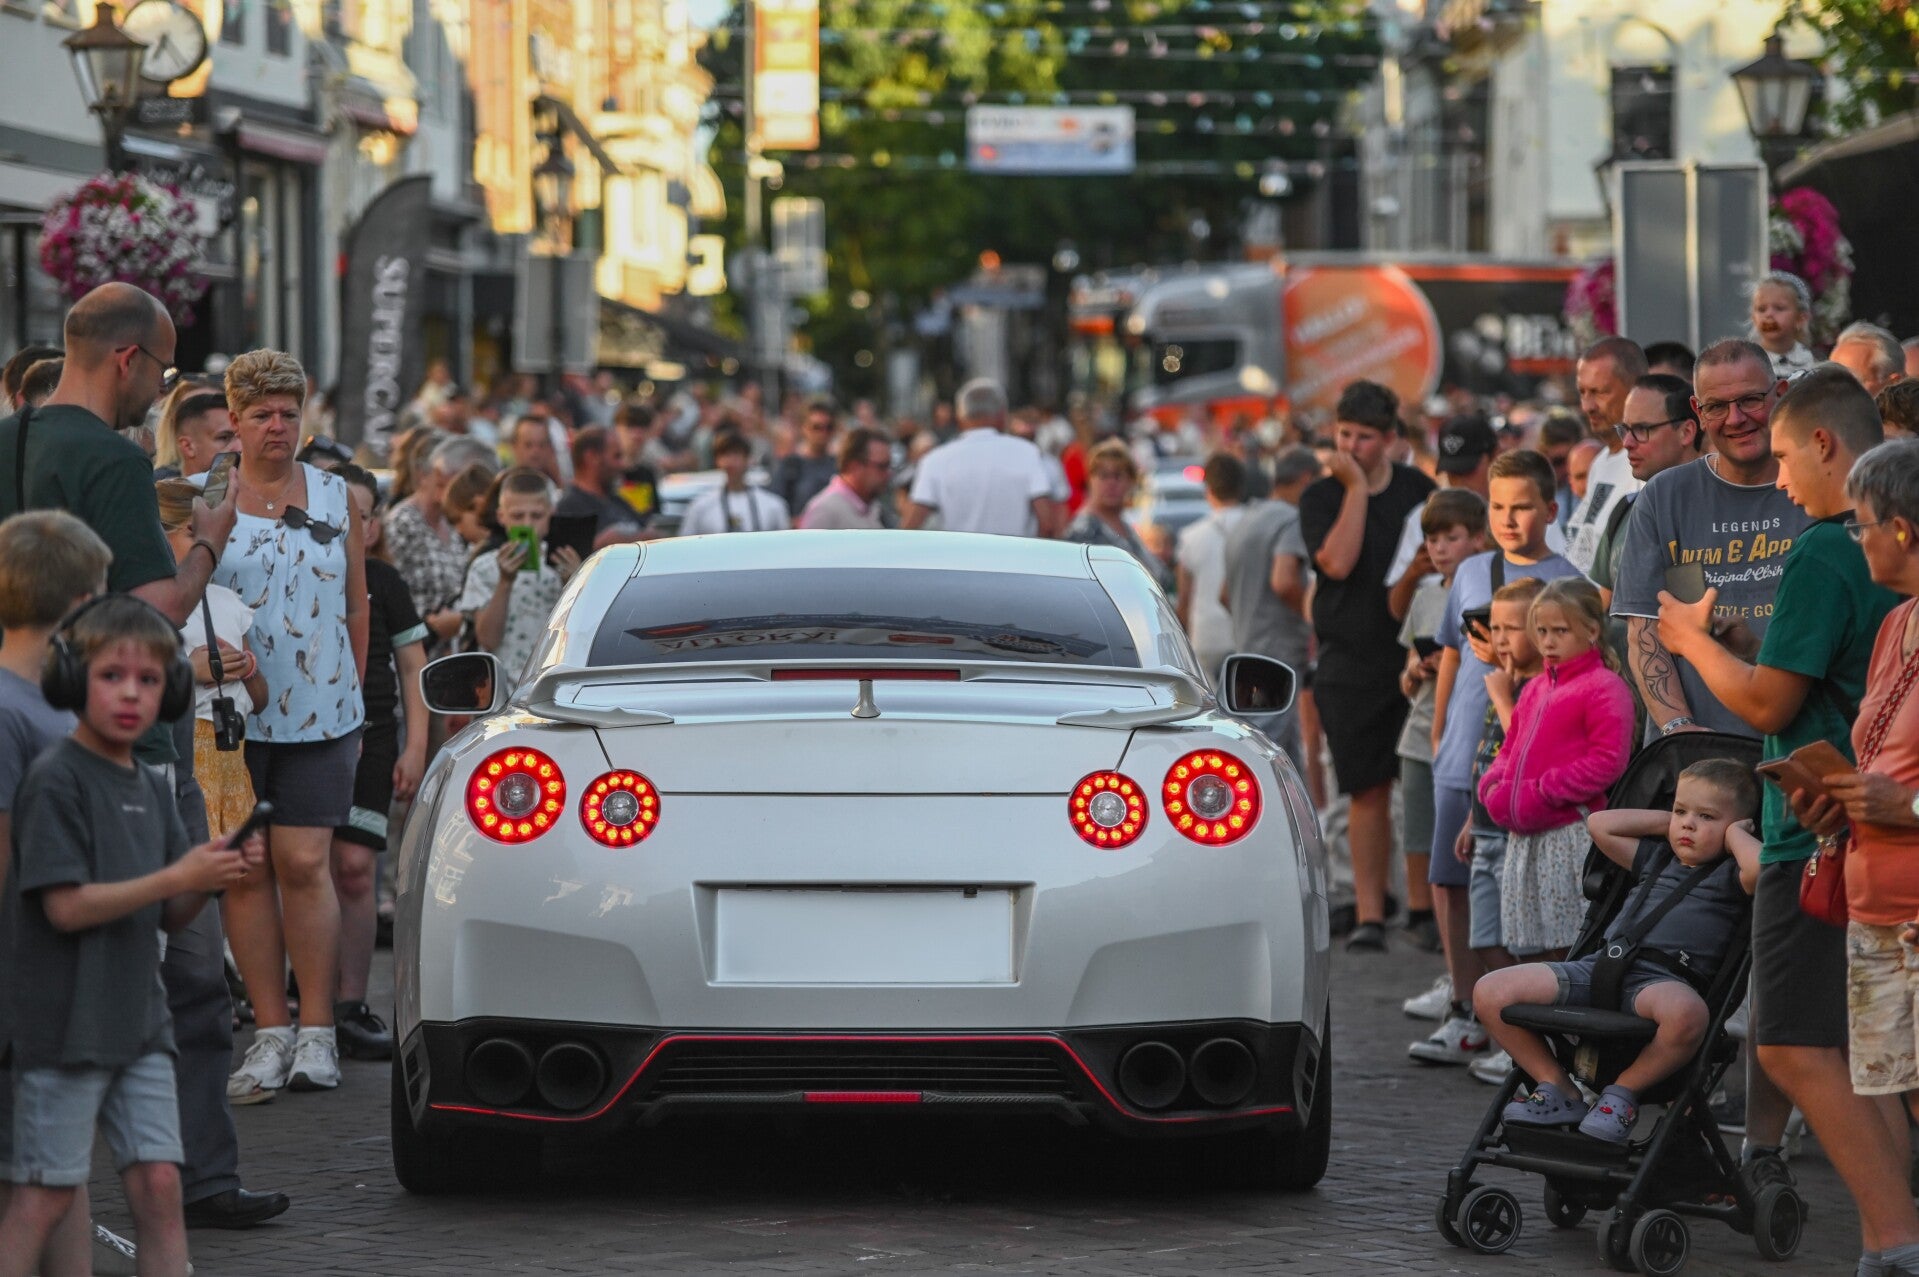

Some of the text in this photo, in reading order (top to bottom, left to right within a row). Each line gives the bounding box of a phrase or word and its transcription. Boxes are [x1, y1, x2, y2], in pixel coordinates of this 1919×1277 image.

[1712, 517, 1781, 533] LEGENDS
[1747, 533, 1793, 563] APP
[1704, 567, 1753, 587] riginal
